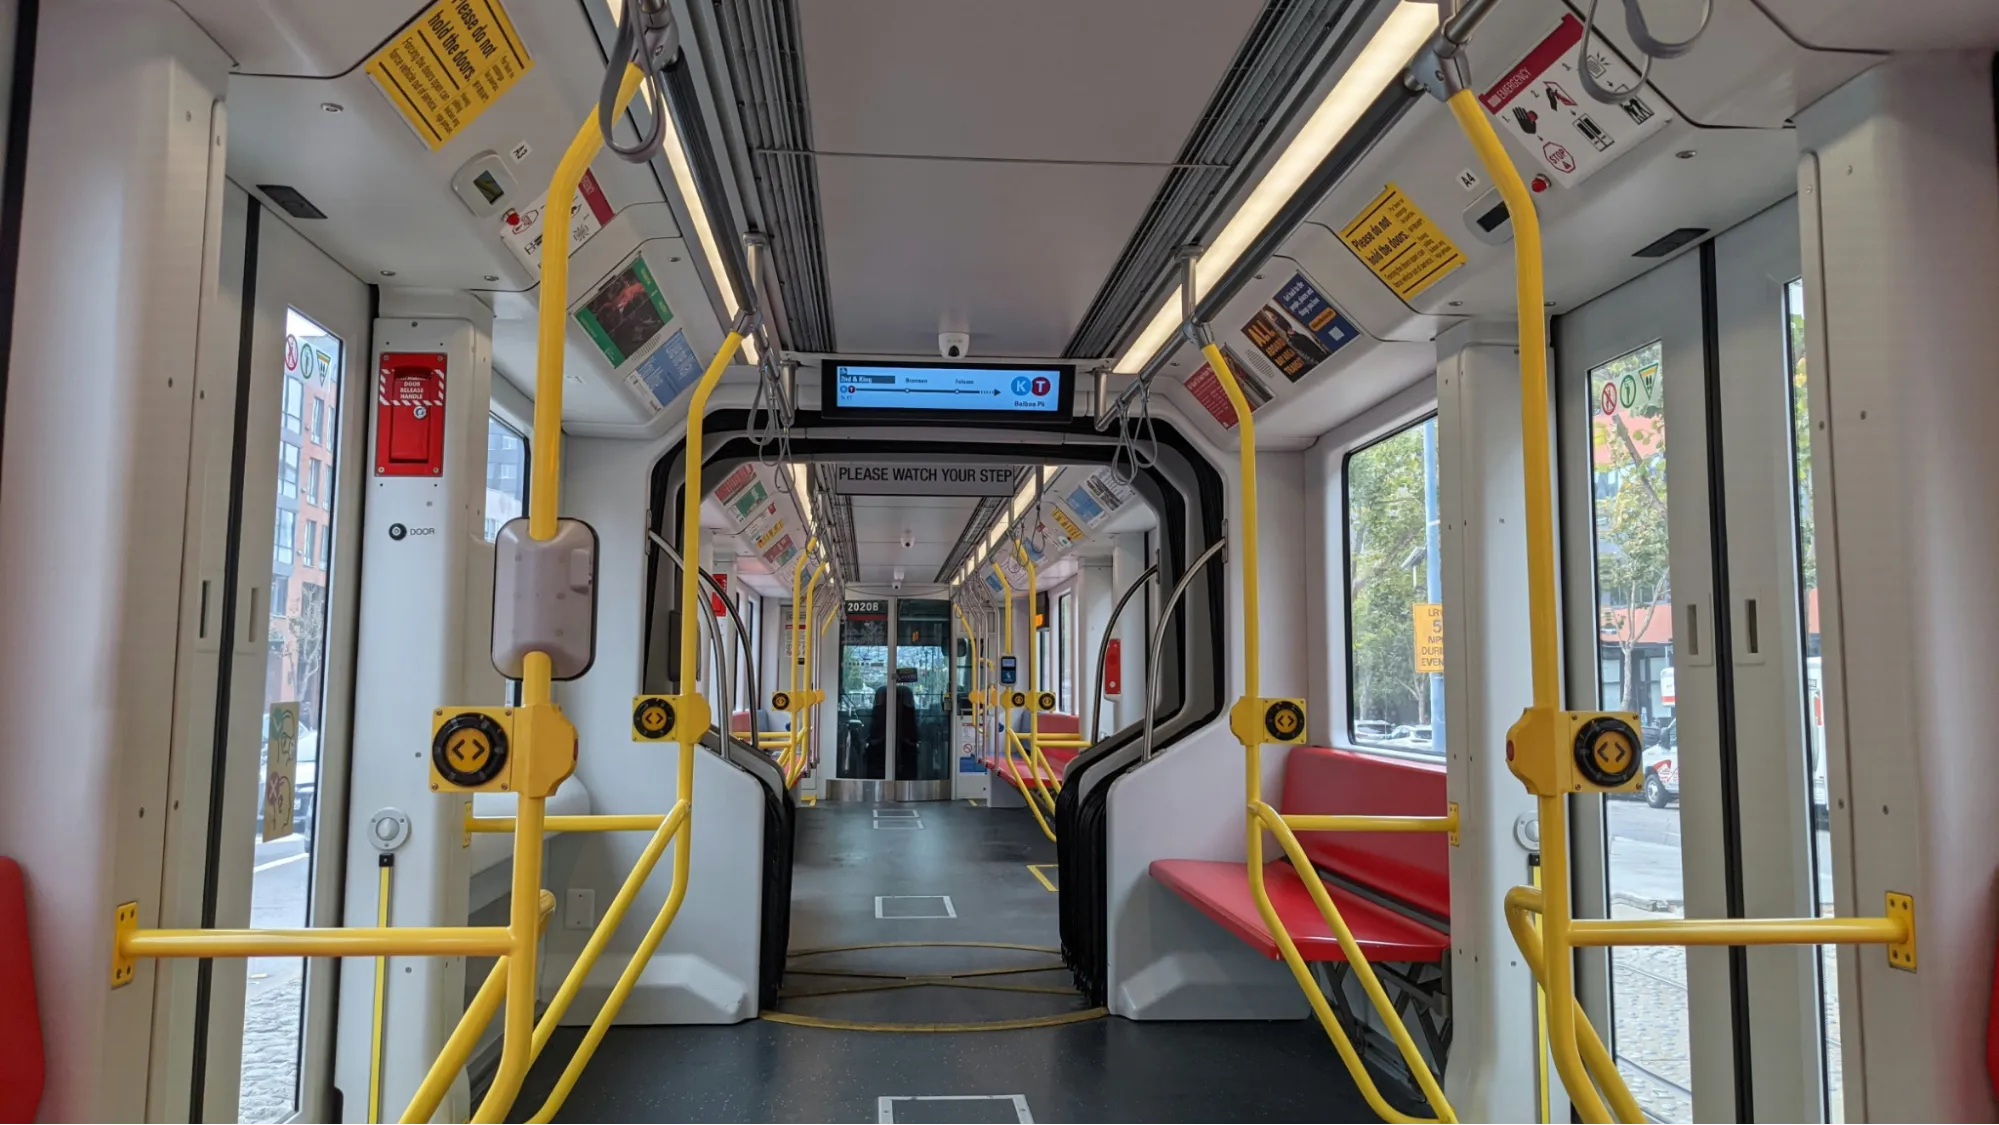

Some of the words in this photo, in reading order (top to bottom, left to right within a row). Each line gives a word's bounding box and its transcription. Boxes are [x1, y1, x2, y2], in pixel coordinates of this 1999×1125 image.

[451, 0, 478, 30] lease
[471, 24, 487, 43] do
[479, 38, 497, 58] not
[428, 10, 454, 40] hold
[442, 33, 459, 55] the
[452, 49, 475, 82] doors.
[399, 63, 416, 82] vehicle
[411, 80, 422, 90] out
[402, 36, 420, 62] Forcing
[415, 56, 426, 68] the
[421, 65, 435, 81] doors
[430, 78, 443, 92] open
[439, 90, 449, 100] can
[1496, 68, 1531, 99] EMERGENCY
[512, 145, 528, 160] A3
[1549, 148, 1565, 164] STOP
[1461, 172, 1476, 188] A4
[1351, 231, 1375, 251] Please
[1370, 225, 1382, 236] do
[1378, 216, 1392, 230] not
[1365, 248, 1383, 265] hold
[1378, 244, 1392, 256] the
[1387, 231, 1409, 248] doors.
[1248, 320, 1275, 346] ALL
[1016, 380, 1026, 392] K
[1036, 381, 1046, 392] T
[839, 467, 889, 481] PLEASE
[892, 468, 937, 481] WATCH
[942, 468, 976, 482] YOUR
[980, 469, 1012, 483] STEP
[1433, 620, 1442, 633] 5
